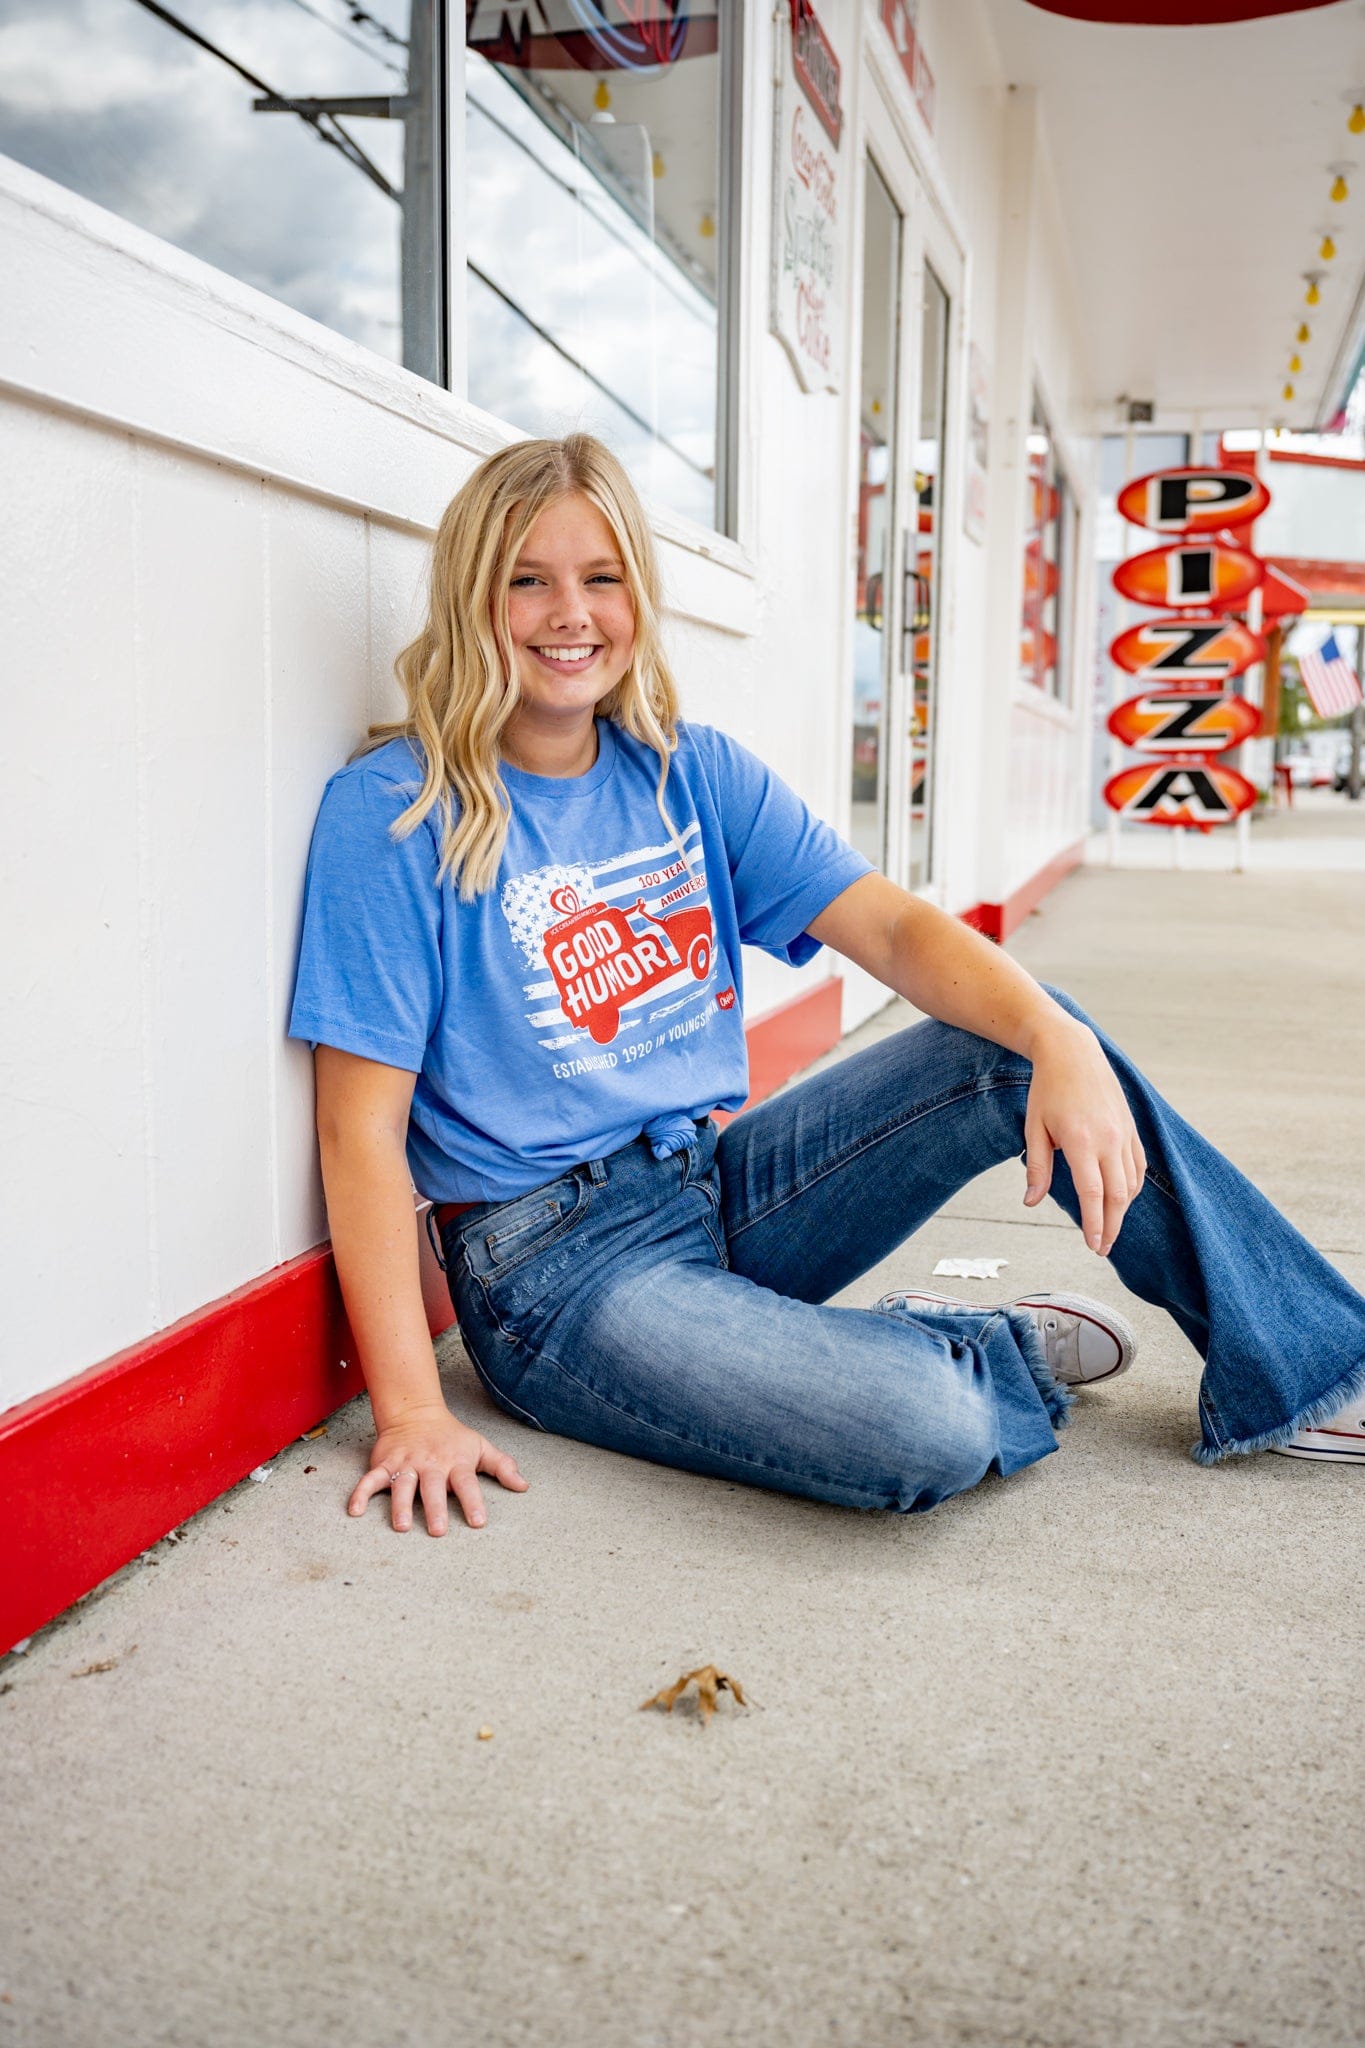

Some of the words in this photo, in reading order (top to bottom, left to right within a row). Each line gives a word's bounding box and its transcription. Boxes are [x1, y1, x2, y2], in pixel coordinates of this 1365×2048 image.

[1120, 475, 1256, 820] PIZZA
[639, 873, 660, 889] 100
[552, 920, 622, 980] GOOD
[565, 940, 666, 1018] HUMOR
[553, 1053, 618, 1080] ESTABHED
[622, 1039, 652, 1064] 1920
[655, 1031, 667, 1049] IN
[668, 999, 719, 1042] YOUNGSWN
